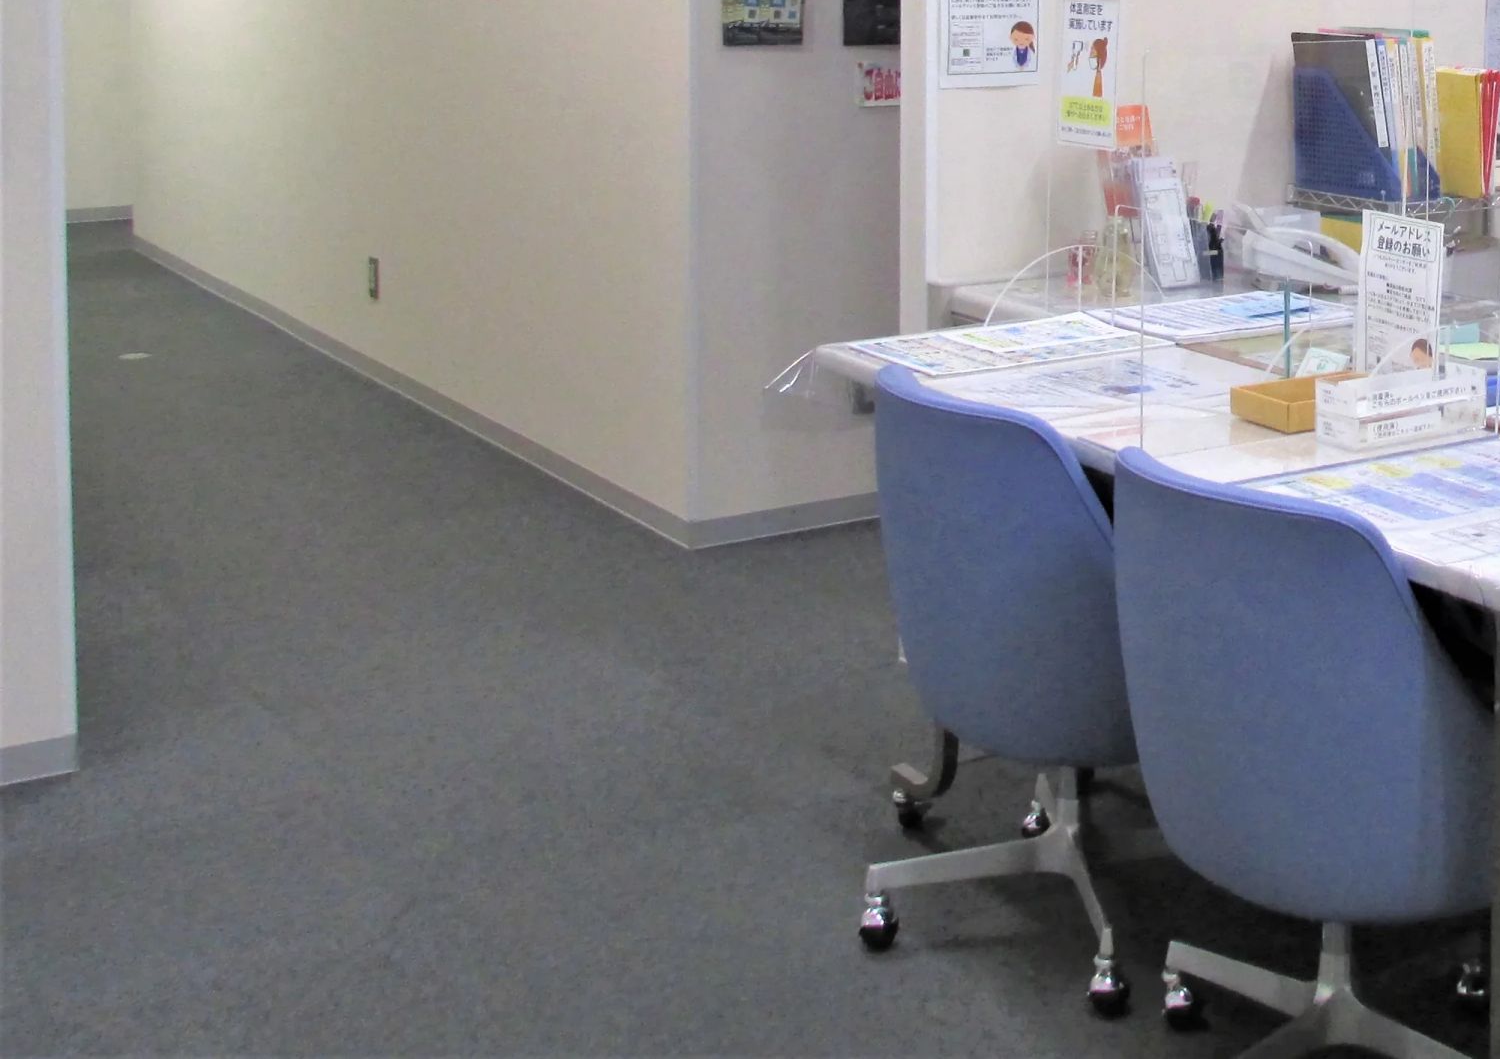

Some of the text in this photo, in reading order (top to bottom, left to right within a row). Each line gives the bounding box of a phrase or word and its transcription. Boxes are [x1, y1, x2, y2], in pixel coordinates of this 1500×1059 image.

[1069, 2, 1104, 16] 体温測定を
[1068, 18, 1113, 33] 実施しています
[1377, 221, 1431, 242] メールアドレス
[1377, 235, 1431, 257] 登録のお願い
